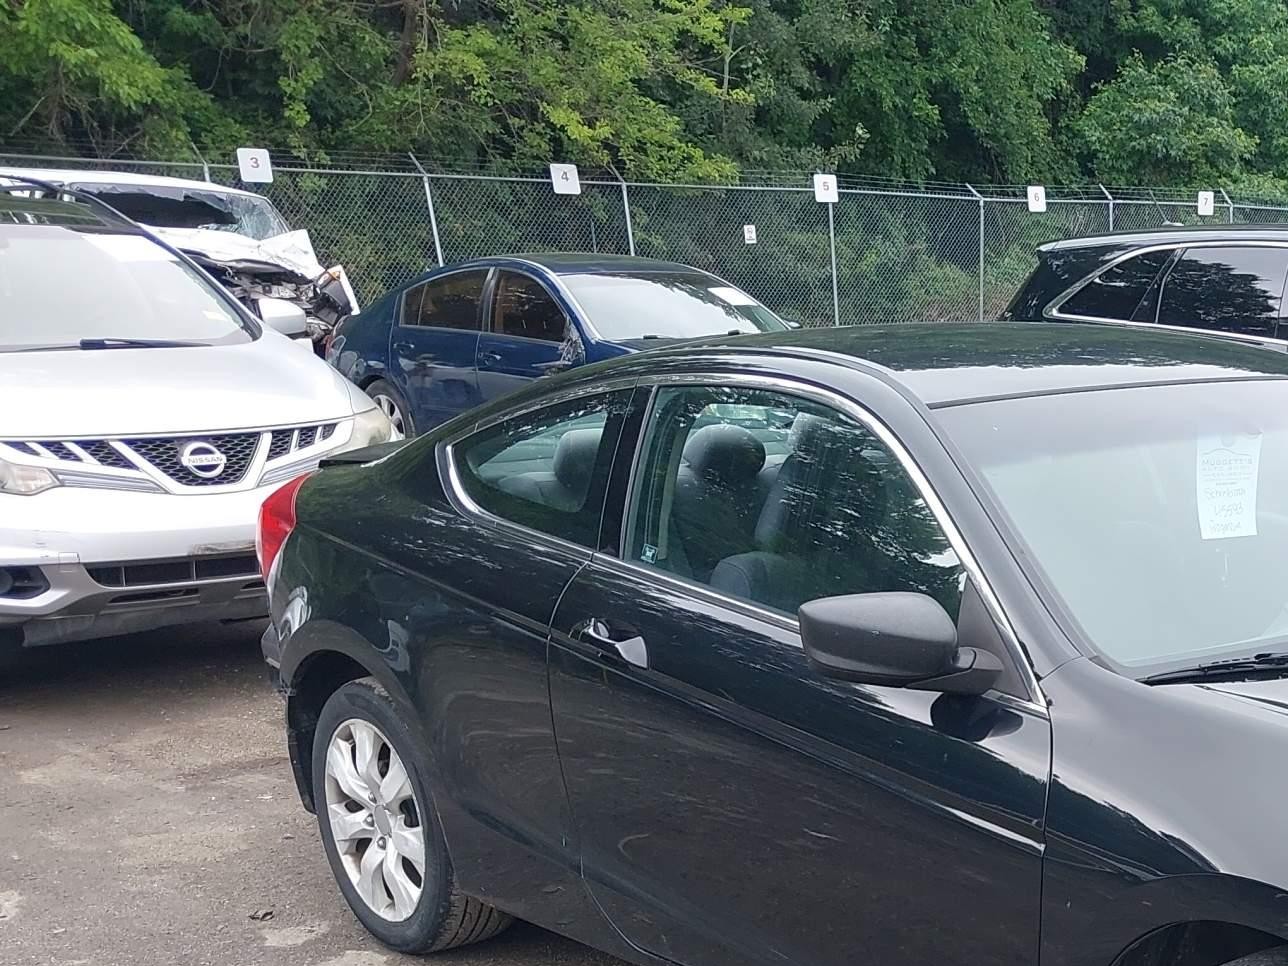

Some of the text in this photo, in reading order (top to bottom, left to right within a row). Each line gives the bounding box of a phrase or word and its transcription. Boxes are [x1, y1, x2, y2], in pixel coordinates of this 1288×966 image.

[249, 157, 260, 169] 3
[561, 171, 570, 182] 4
[822, 181, 830, 191] 5
[1034, 192, 1040, 202] 6
[1203, 197, 1209, 206] 7
[188, 456, 223, 465] NISSAN
